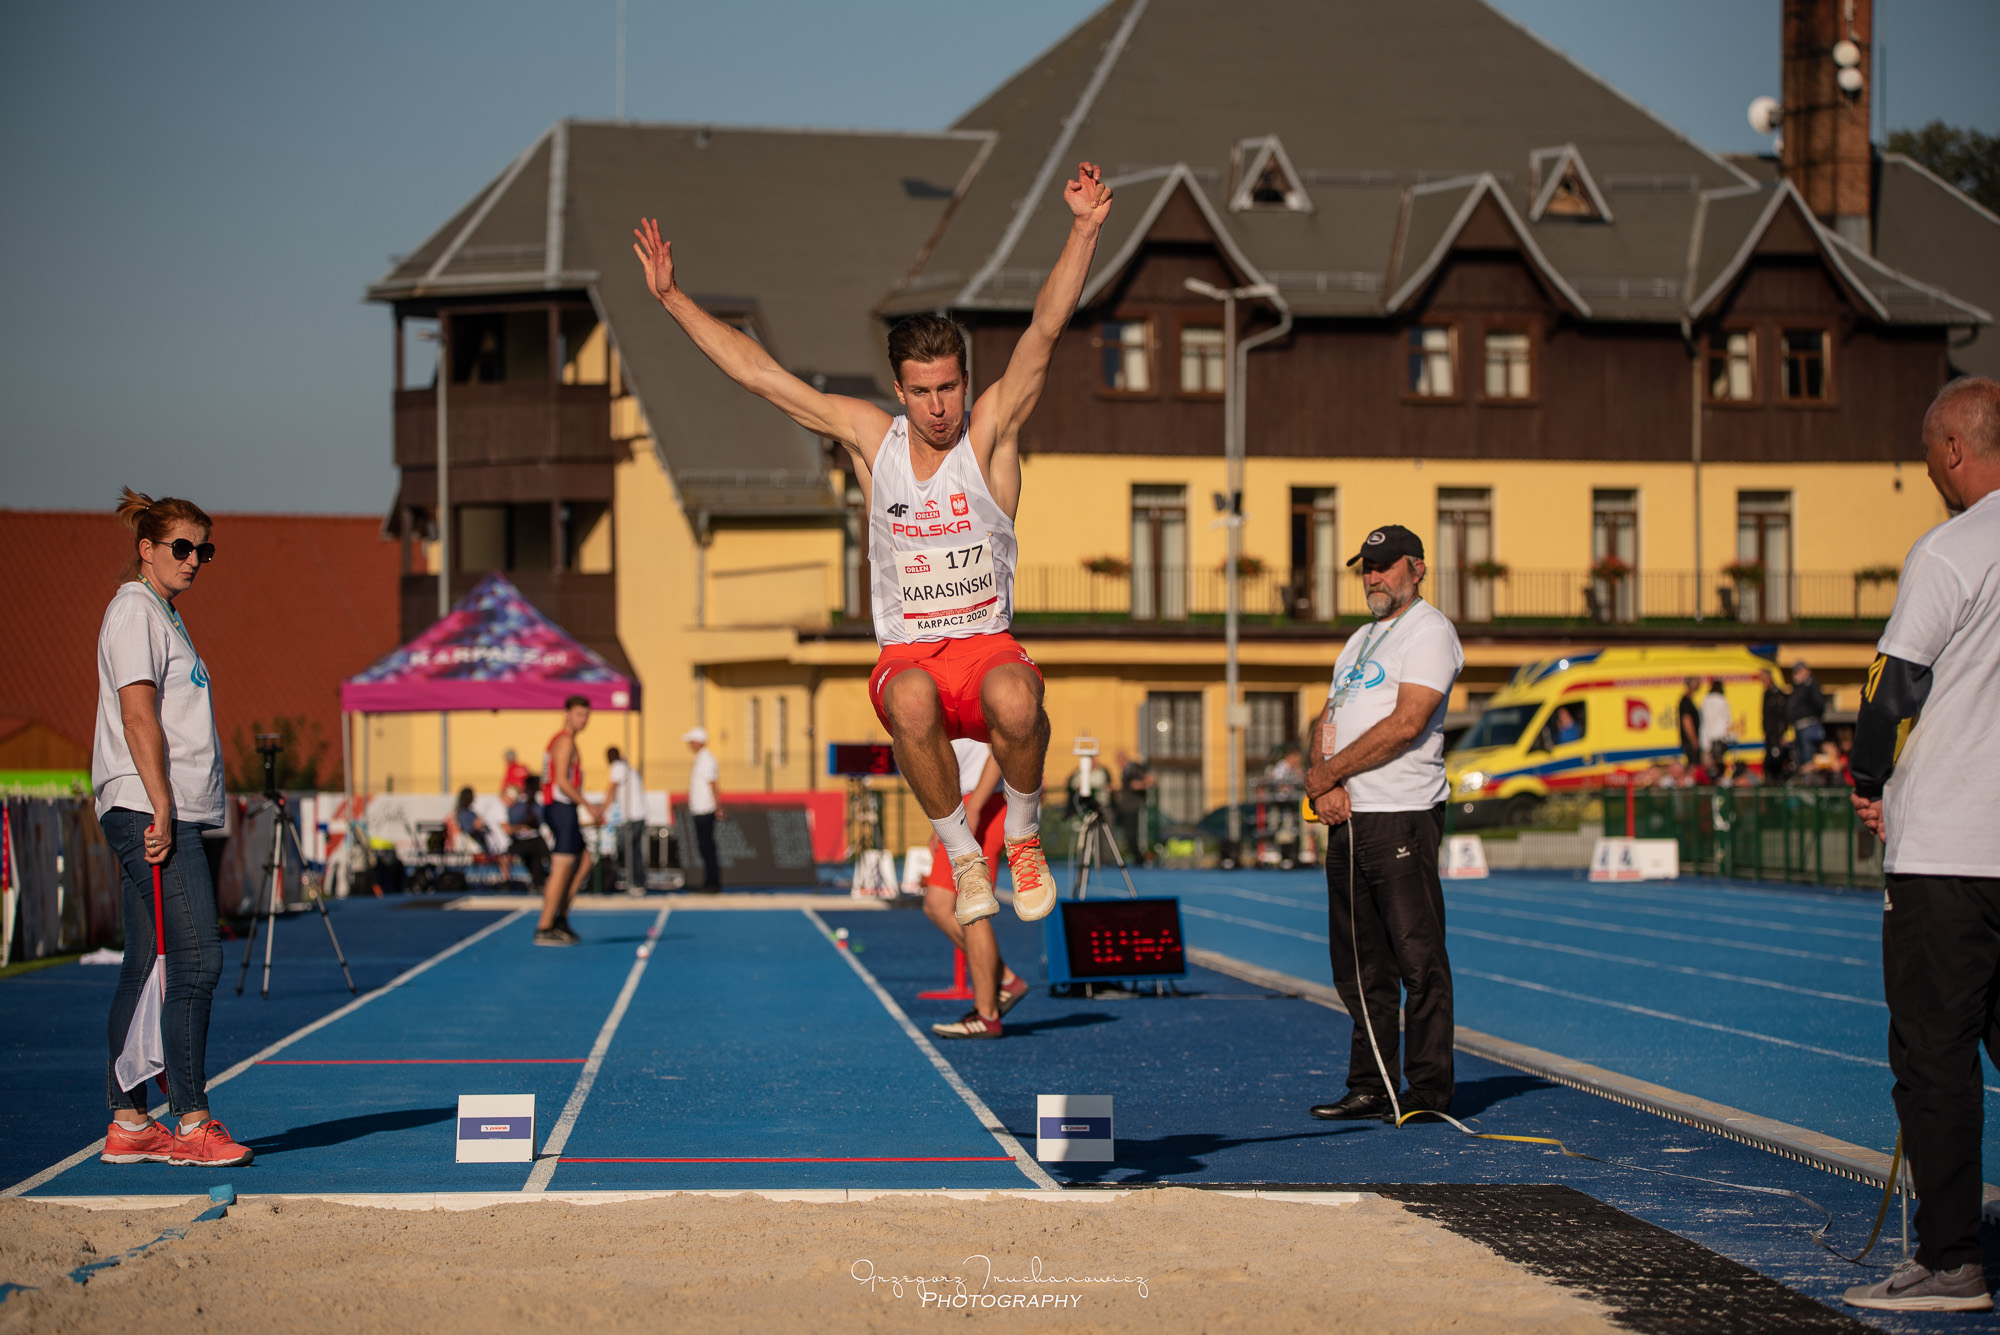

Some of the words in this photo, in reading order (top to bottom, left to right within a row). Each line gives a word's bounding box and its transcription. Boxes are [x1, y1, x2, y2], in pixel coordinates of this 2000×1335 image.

[886, 502, 910, 518] 4F
[916, 510, 940, 520] ORLEN
[892, 520, 972, 538] POLSKA
[945, 544, 984, 570] 177
[905, 564, 931, 574] ORLEN
[902, 572, 993, 602] KARASIŃSKI
[917, 615, 965, 630] KARPACZ
[966, 608, 988, 623] 2020
